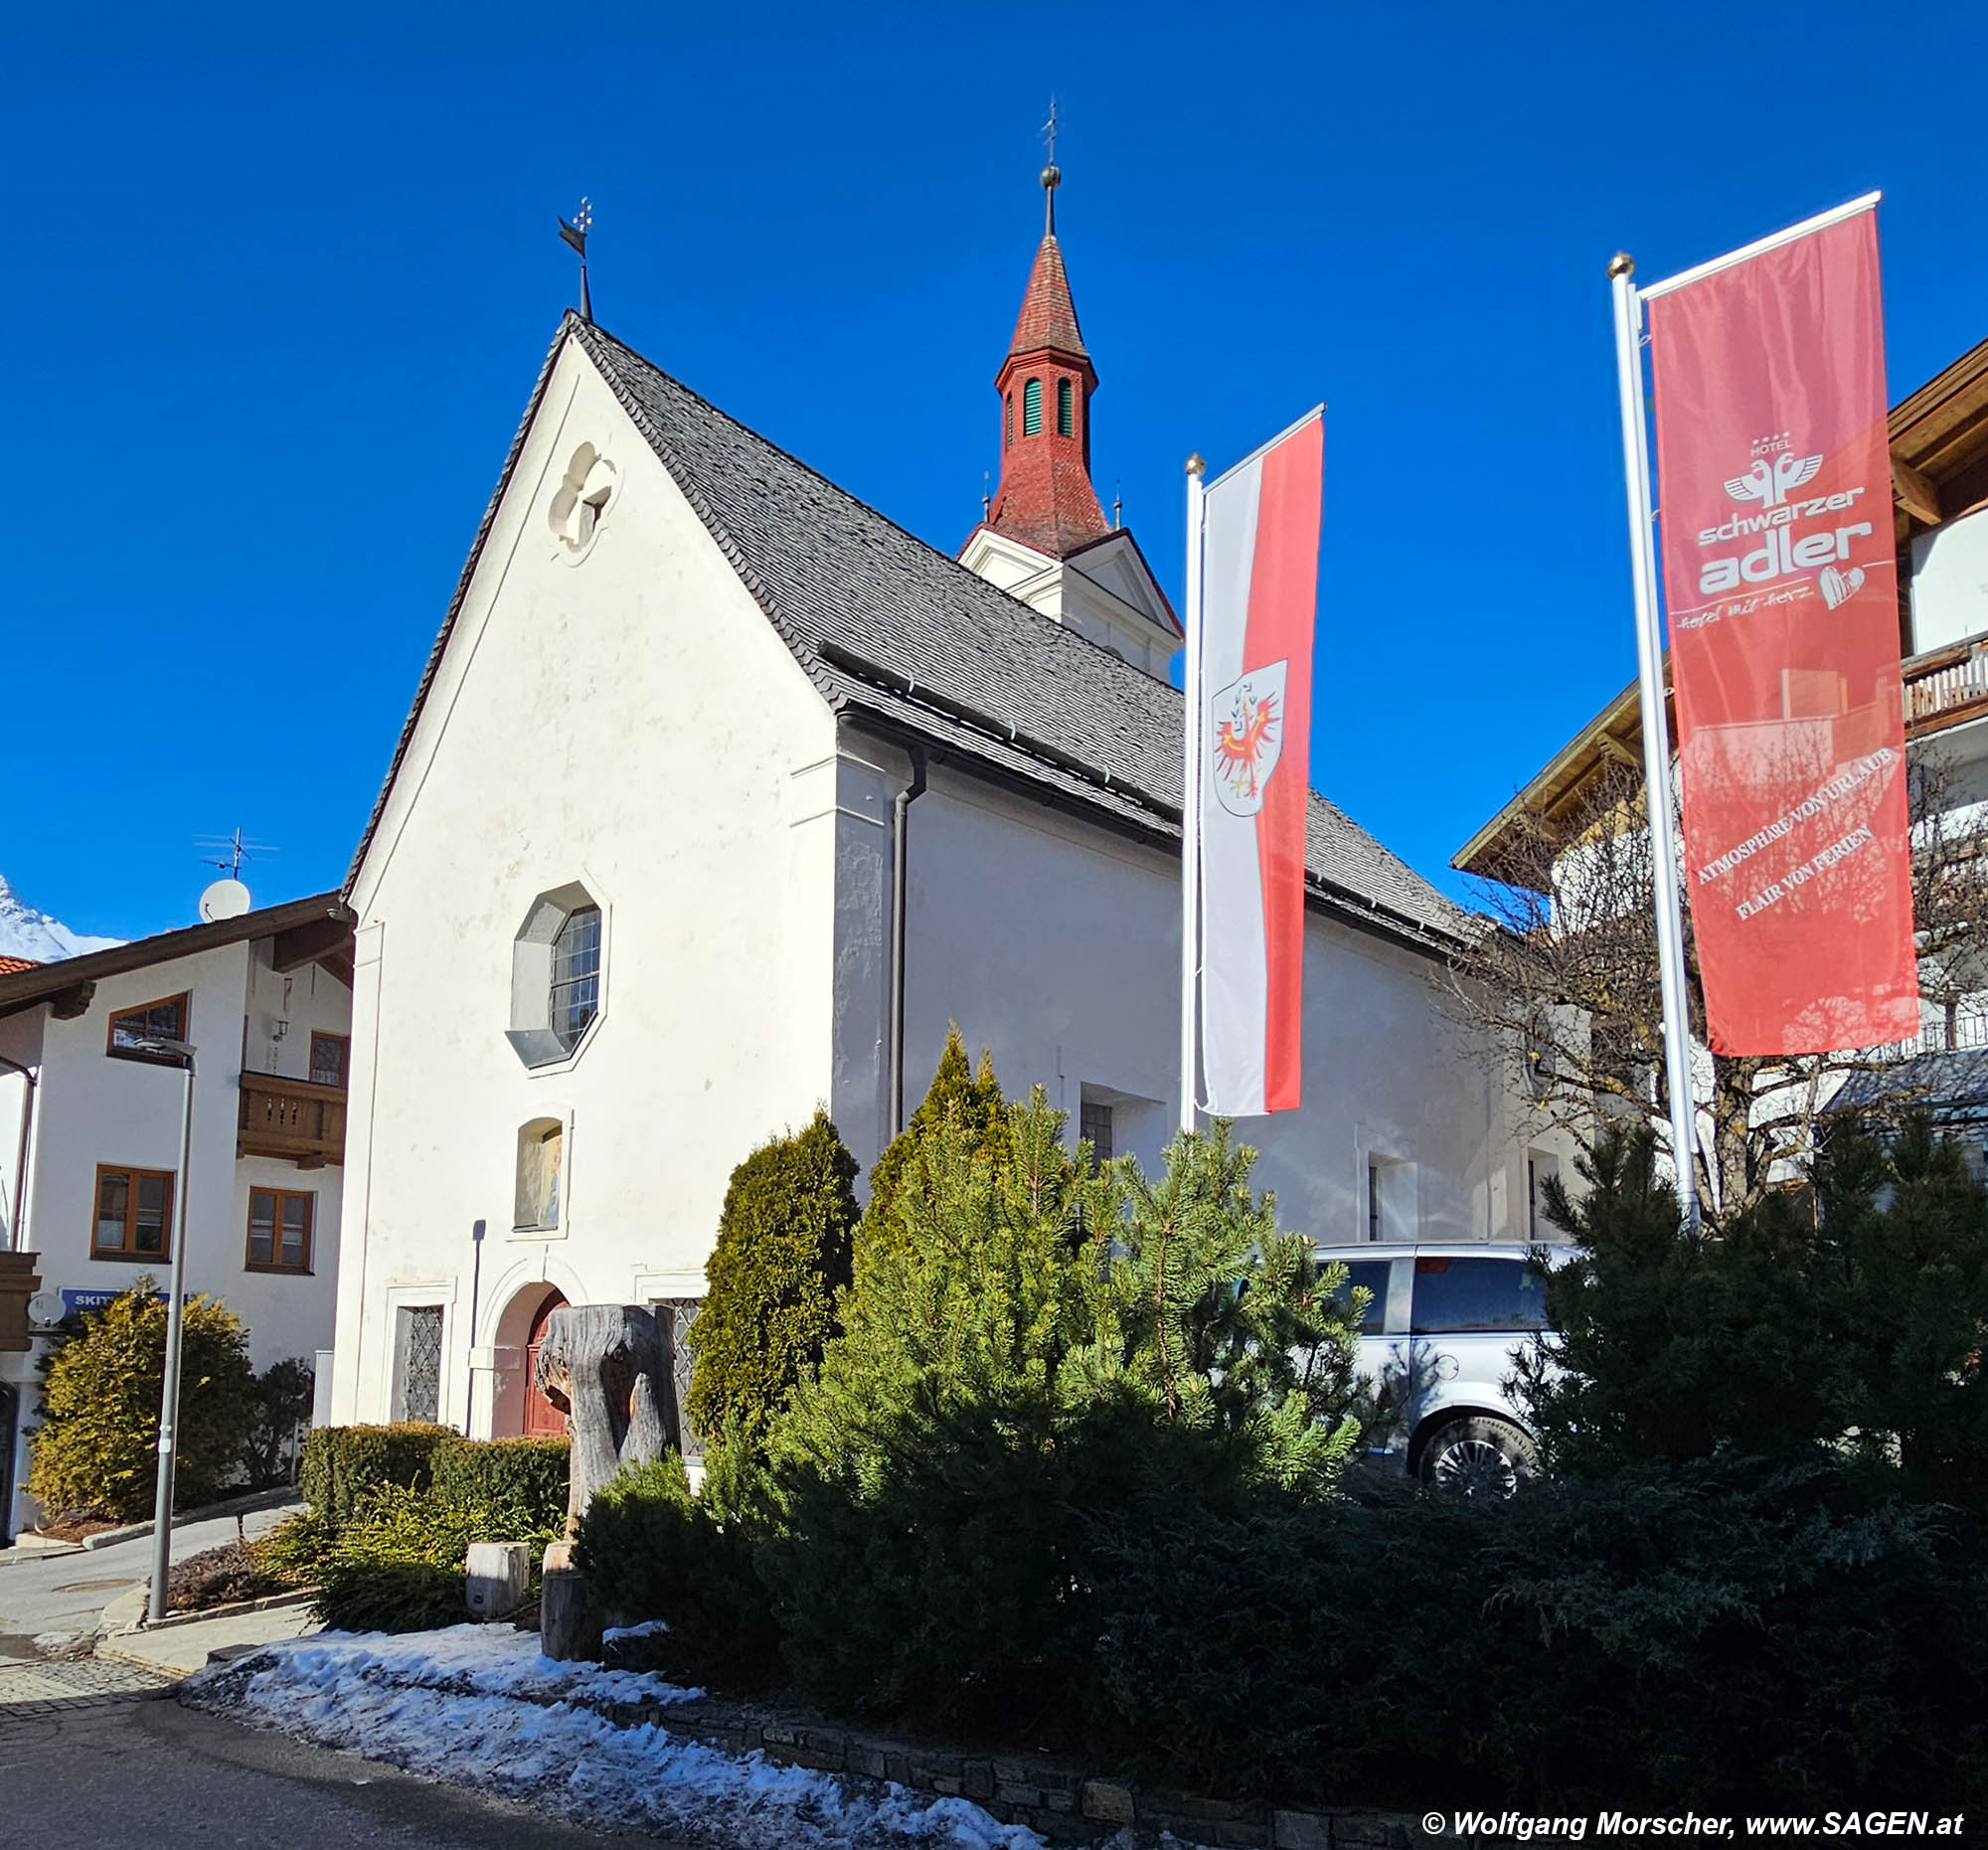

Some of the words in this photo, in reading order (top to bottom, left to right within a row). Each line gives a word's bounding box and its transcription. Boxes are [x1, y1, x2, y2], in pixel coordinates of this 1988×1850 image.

[1750, 440, 1792, 456] HOTEL
[1698, 487, 1865, 546] schwarzer
[1699, 522, 1872, 594] adler
[1790, 792, 1829, 824] VON
[1822, 747, 1894, 800] URLAUB
[1735, 883, 1785, 922] FLAIR
[1781, 864, 1816, 891] VON
[1811, 823, 1874, 872] FERIEN
